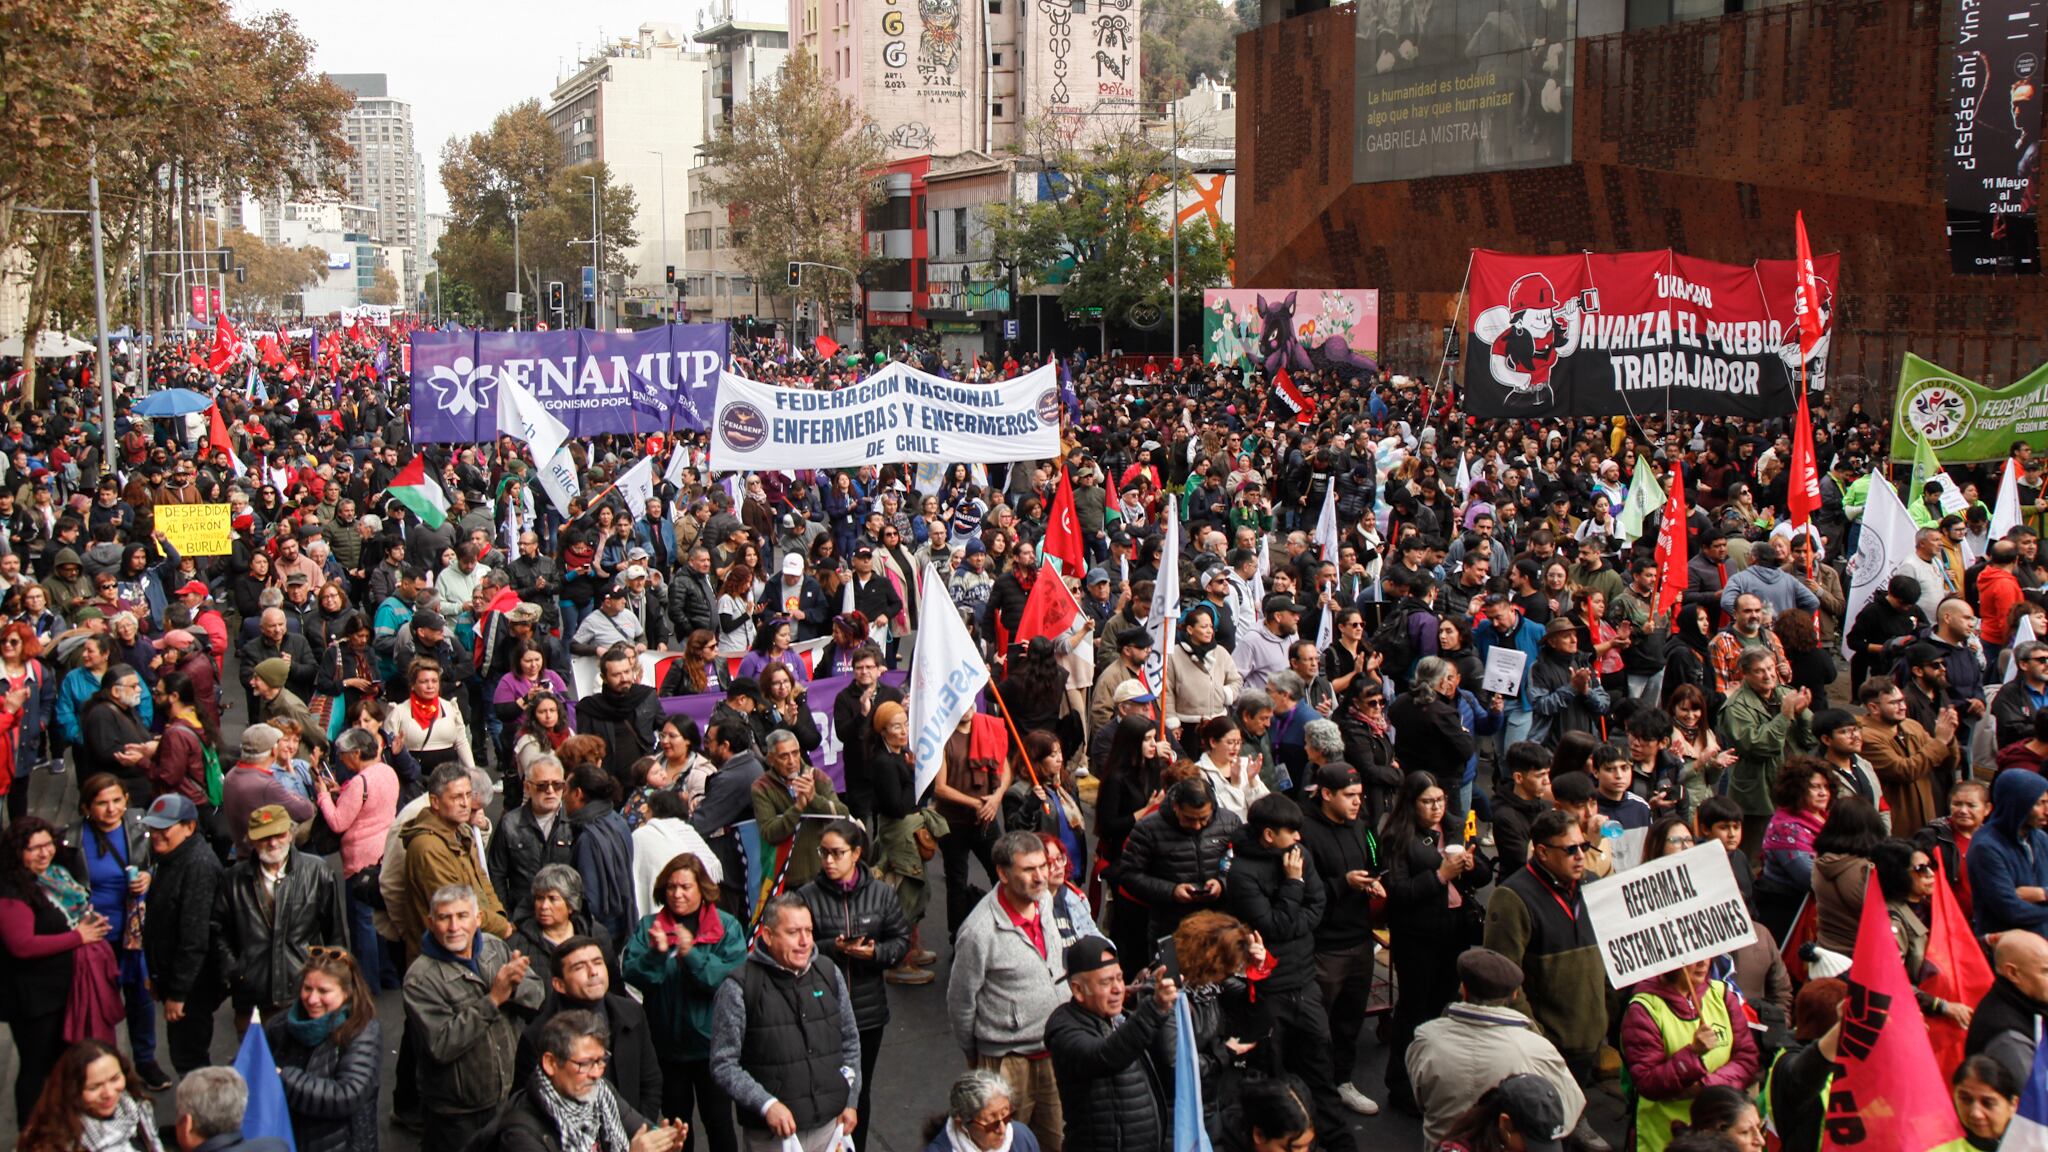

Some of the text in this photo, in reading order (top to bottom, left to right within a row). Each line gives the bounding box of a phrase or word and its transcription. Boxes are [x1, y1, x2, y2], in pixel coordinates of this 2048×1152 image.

[1368, 72, 1496, 105] La humanidad es todavía
[1367, 91, 1515, 127] algo que hay que humanizar
[1366, 122, 1488, 153] GABRIELA MISTRAL
[1982, 177, 2029, 191] 11 Mayo
[1999, 190, 2010, 201] al
[1580, 310, 1782, 356] AVANZA EL PUEBLO
[504, 350, 721, 397] ENAMUP
[905, 373, 1005, 408] NACIONAL
[1610, 351, 1760, 396] TRABAJADOR
[539, 399, 600, 410] AGONISMO
[772, 401, 1039, 444] ENFERMERAS Y ENFERMEROS
[865, 434, 940, 458] DE CHILE
[165, 505, 229, 518] DESPEDIDA
[1621, 863, 1698, 919] REFORMA AL
[1608, 899, 1749, 976] SISTEMA DE PENSIONES
